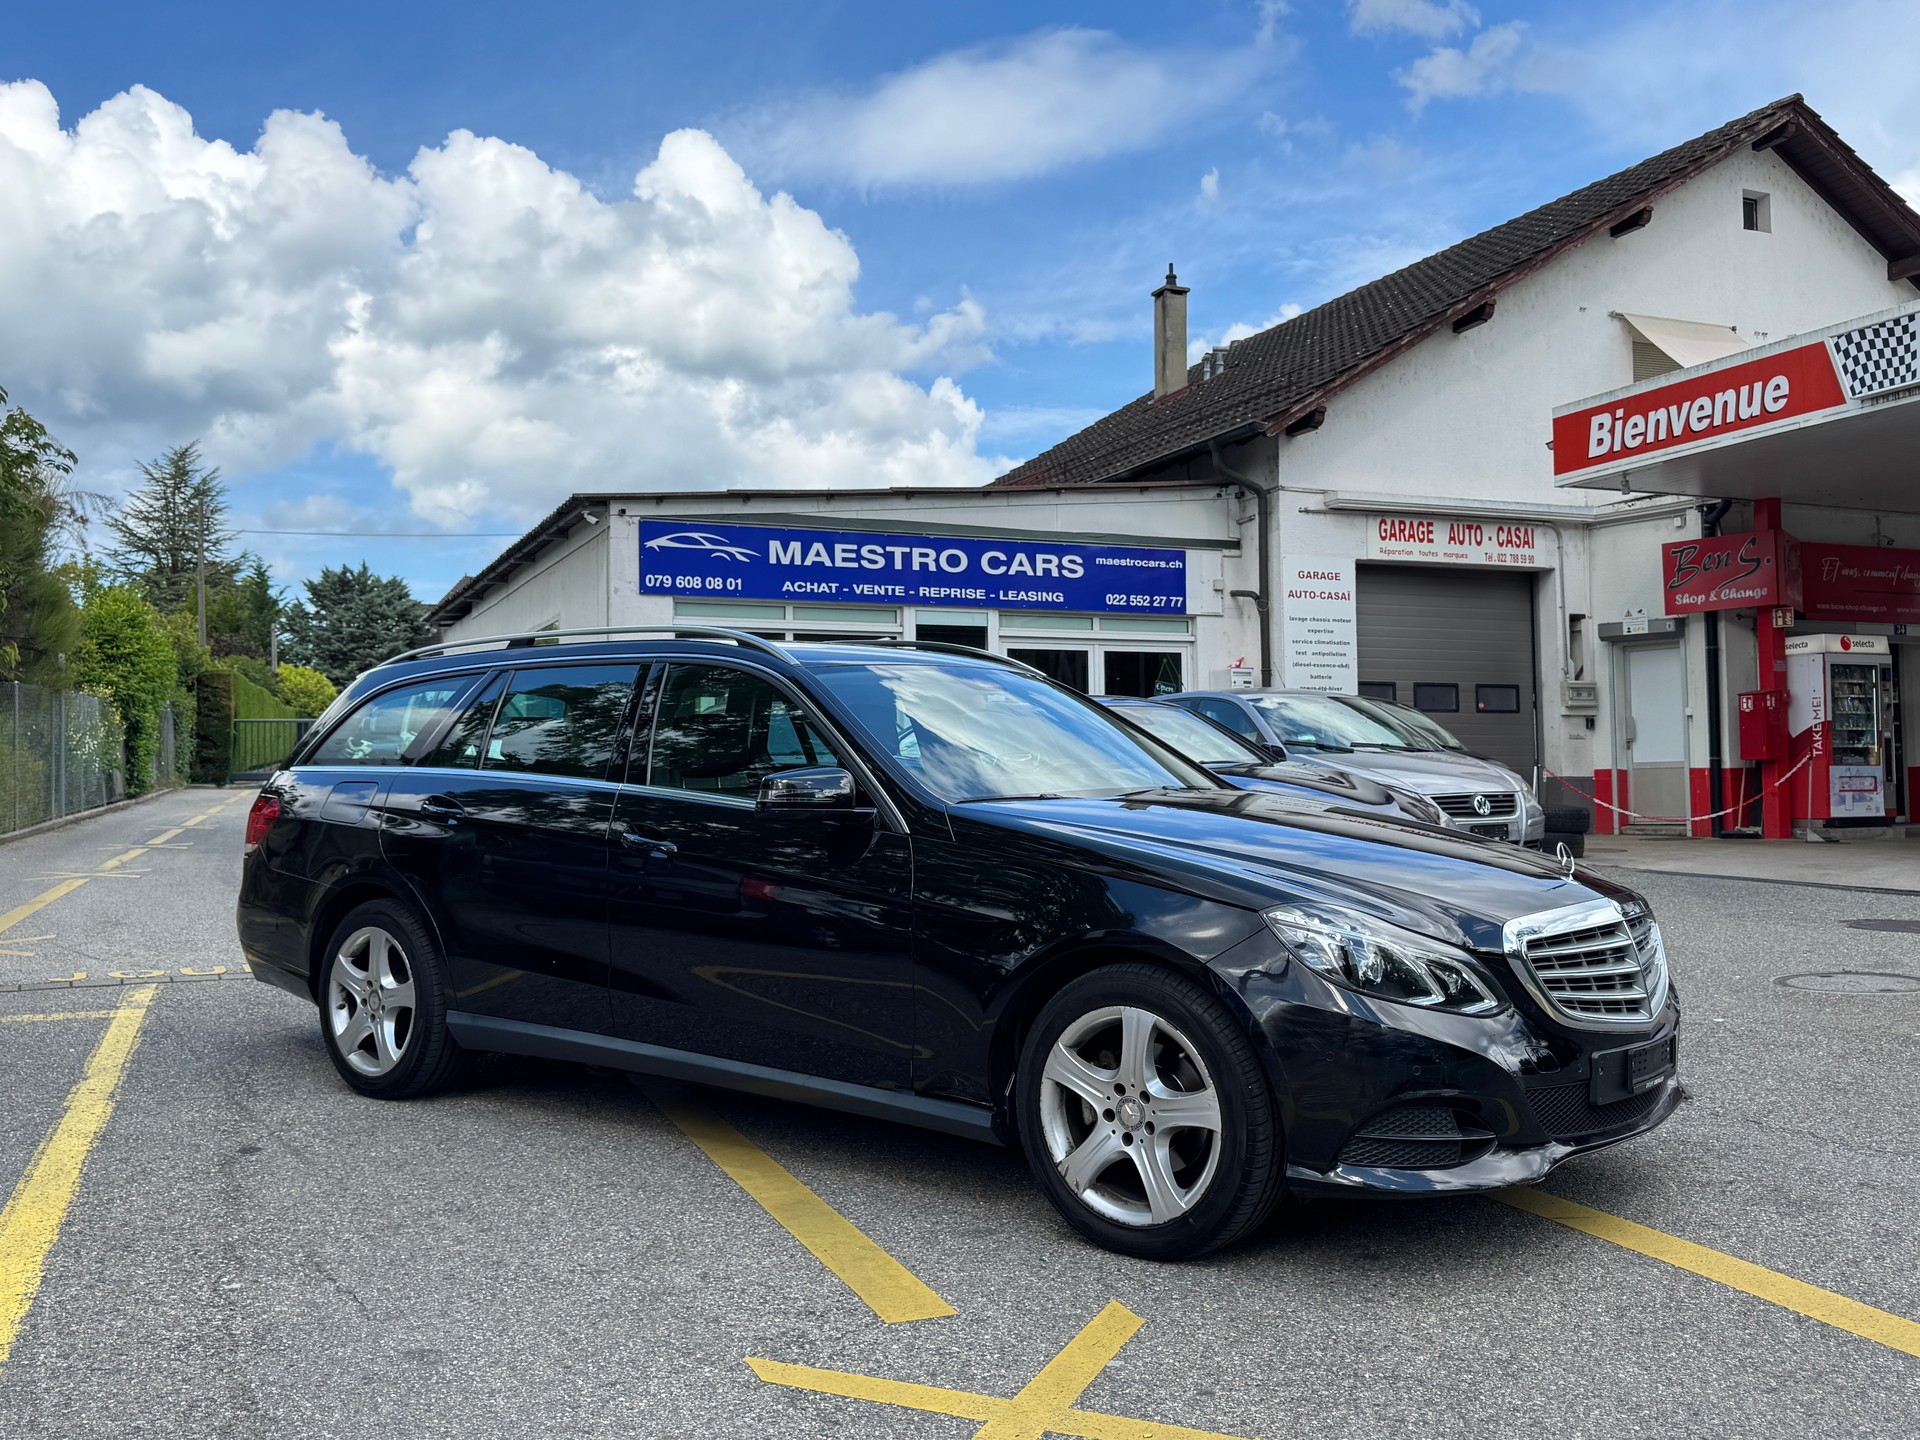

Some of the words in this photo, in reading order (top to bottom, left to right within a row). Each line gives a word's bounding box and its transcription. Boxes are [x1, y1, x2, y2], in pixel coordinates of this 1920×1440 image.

[1588, 374, 1789, 459] Bienvenue
[1378, 518, 1434, 543] GARAGE
[1447, 523, 1483, 546] AUTO
[1496, 525, 1535, 549] CASAI
[768, 539, 969, 573] MAESTRO
[980, 551, 1085, 579] CARS
[1095, 557, 1183, 569] maestrocars.ch
[1667, 545, 1731, 590] Ben
[645, 574, 672, 588] 079
[676, 575, 702, 589] 608
[705, 576, 723, 590] 08
[726, 578, 742, 591] 01
[1297, 570, 1341, 581] GARAGE
[782, 580, 839, 593] ACHAT
[853, 583, 905, 596] VENTE
[919, 586, 986, 599] REPRISE
[1000, 590, 1064, 602] LEASING
[1105, 593, 1127, 606] 022
[1129, 594, 1150, 607] 552
[1152, 595, 1167, 607] 27
[1169, 596, 1183, 608] 77
[1675, 593, 1705, 605] Shop
[1709, 590, 1718, 601] &
[1720, 587, 1768, 600] Change
[1852, 640, 1875, 648] selecta
[1155, 682, 1174, 694] Open
[1812, 696, 1821, 720] ME!
[1812, 723, 1823, 757] TAKE
